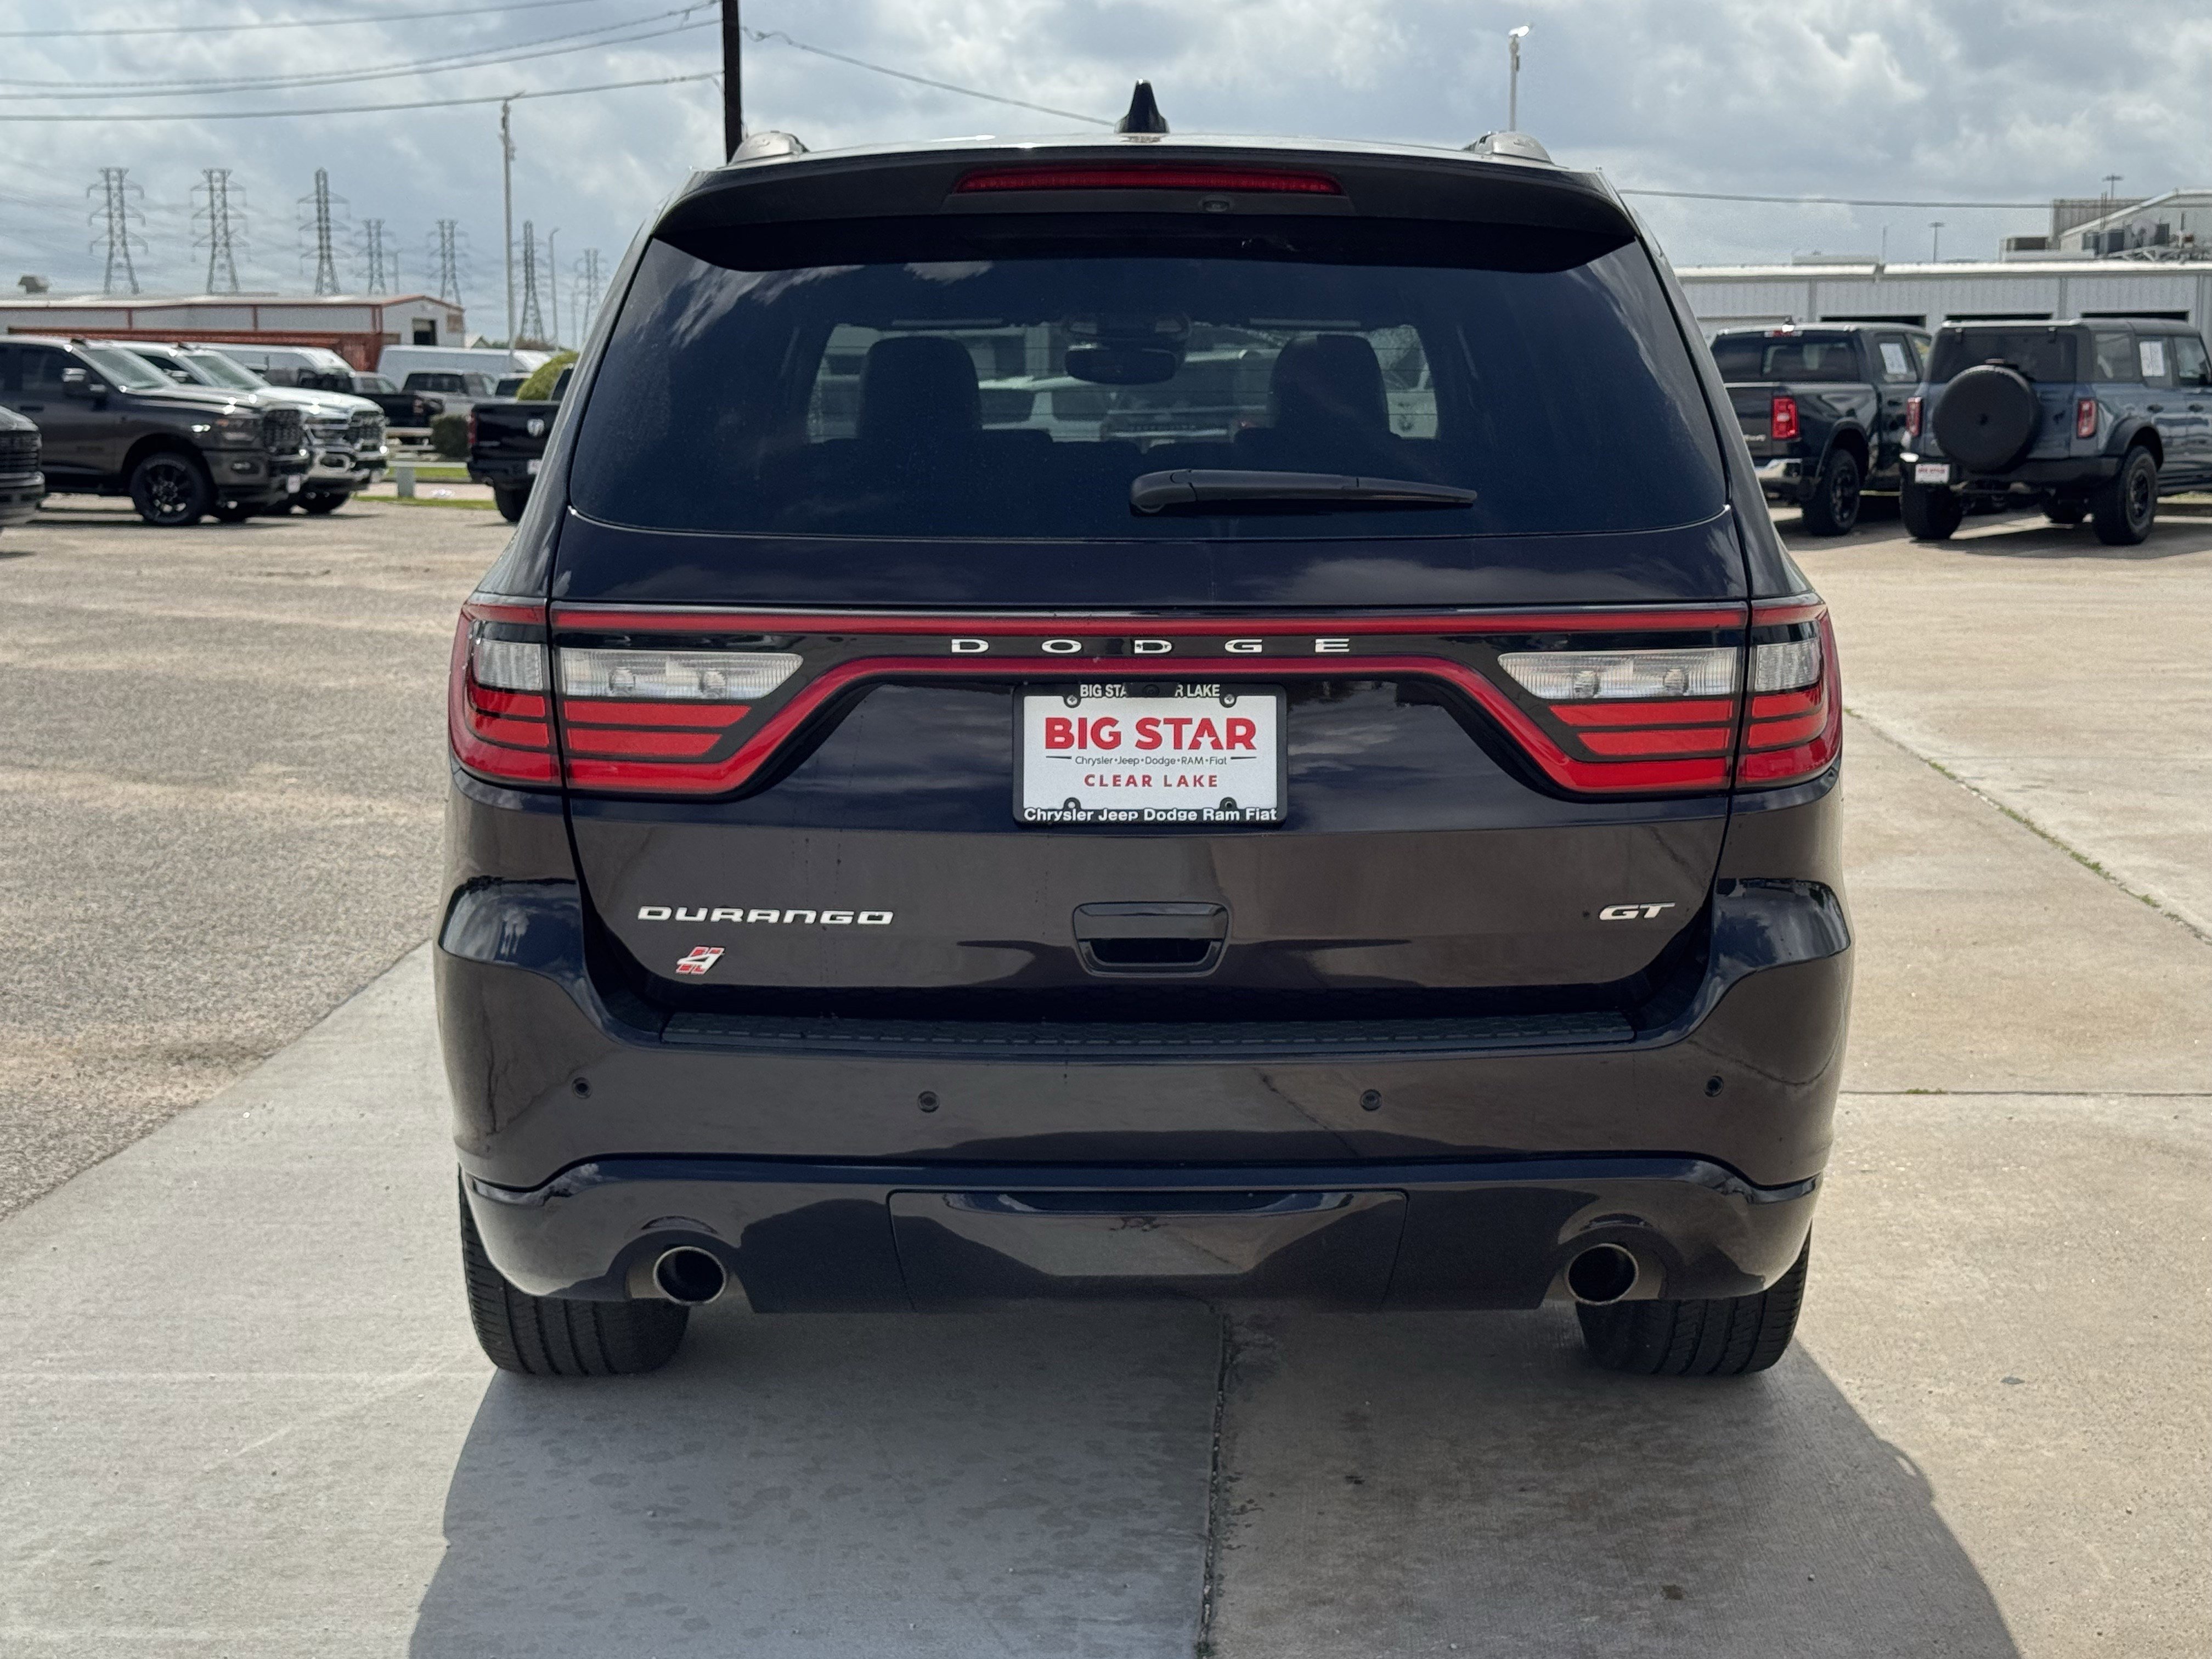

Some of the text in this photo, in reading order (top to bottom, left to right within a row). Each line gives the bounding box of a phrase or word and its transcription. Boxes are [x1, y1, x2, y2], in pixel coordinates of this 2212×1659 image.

[951, 639, 1350, 654] DODGE
[1080, 684, 1102, 697] BIG
[1105, 684, 1127, 697] STA
[1187, 684, 1221, 697] LAKE
[1045, 717, 1257, 750] BIG STAR
[1084, 774, 1218, 787] CLEAR LAKE
[1024, 808, 1277, 822] Chrysler Jeep Dodge Ram Fiat
[637, 906, 894, 925] DURANGO
[1599, 902, 1675, 921] GT
